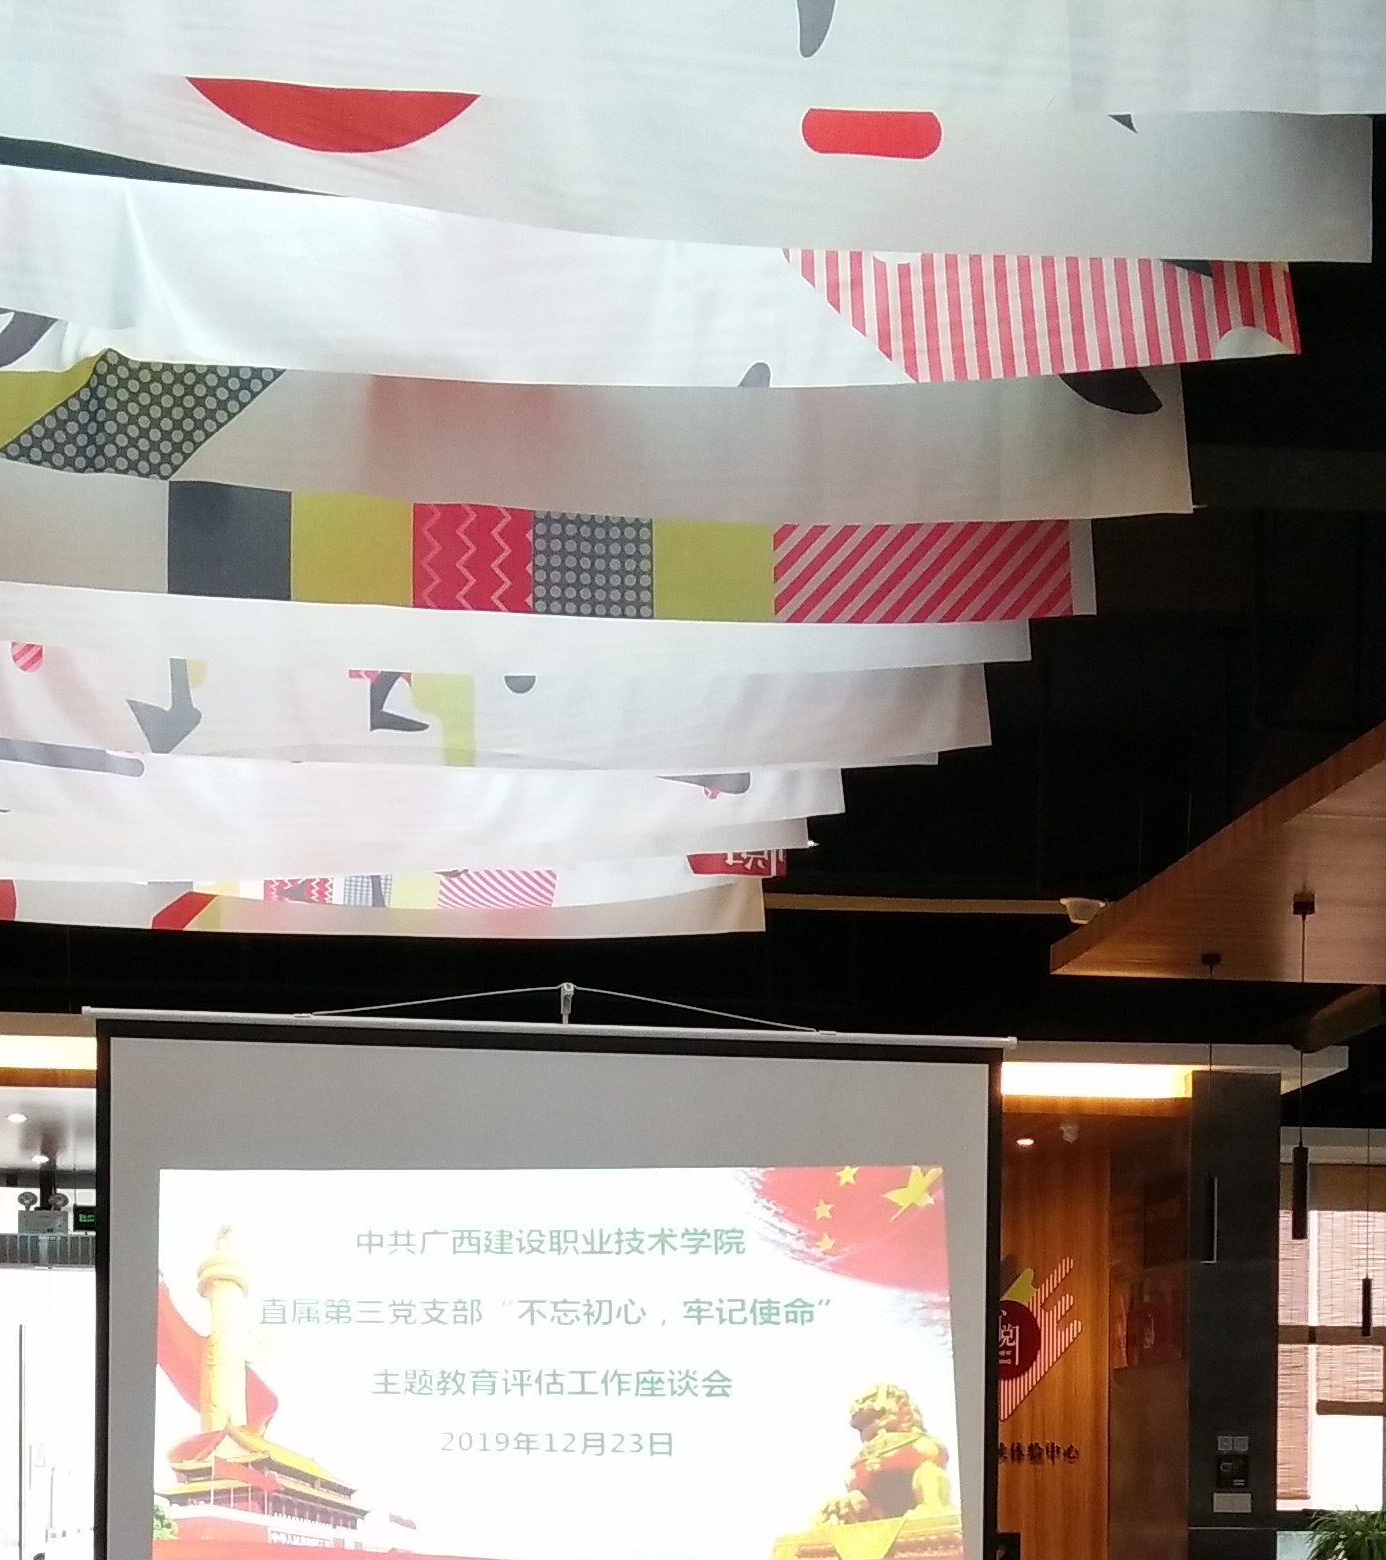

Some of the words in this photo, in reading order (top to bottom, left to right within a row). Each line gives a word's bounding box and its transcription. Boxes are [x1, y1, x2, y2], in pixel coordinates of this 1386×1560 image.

[356, 1227, 746, 1256] 中共广西建设职业技术学院
[371, 1367, 733, 1399] 主题教育评估工作座谈会
[440, 1431, 674, 1457] 2019年12月23日
